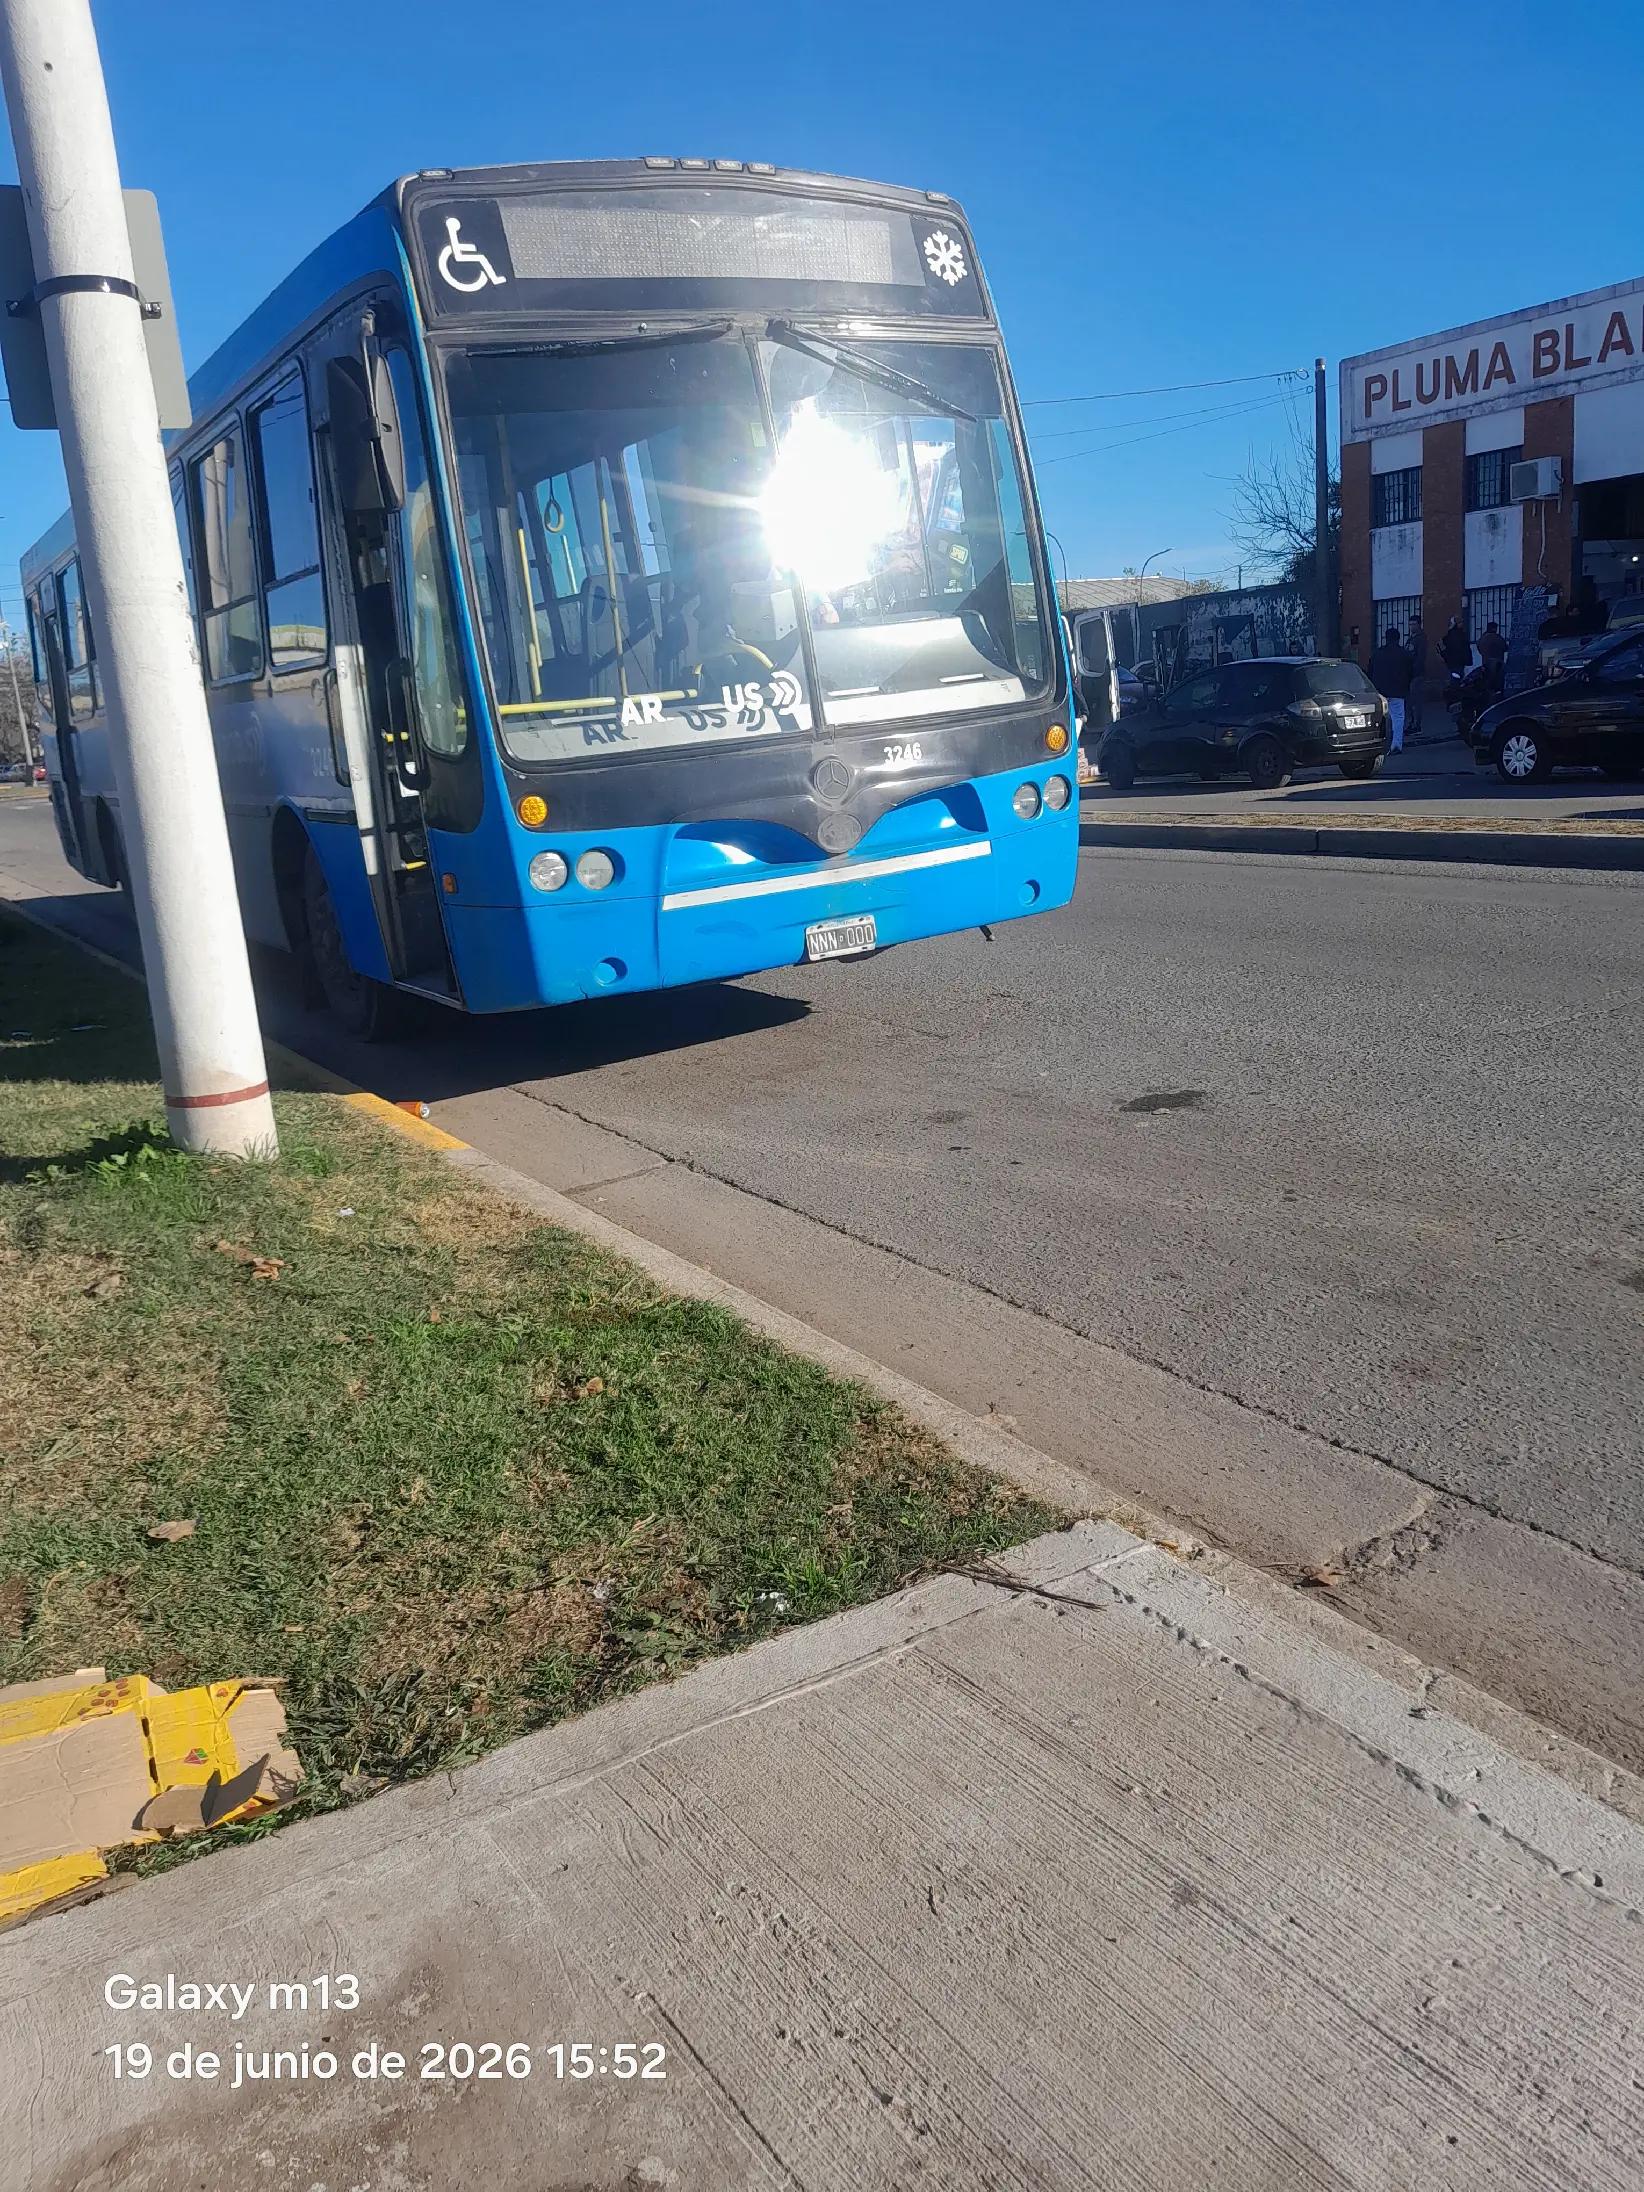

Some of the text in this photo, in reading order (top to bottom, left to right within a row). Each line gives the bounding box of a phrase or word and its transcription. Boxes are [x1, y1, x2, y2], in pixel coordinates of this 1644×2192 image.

[1364, 304, 1644, 418] PLUMA BLA
[722, 682, 764, 713] US
[883, 742, 922, 768] 3246
